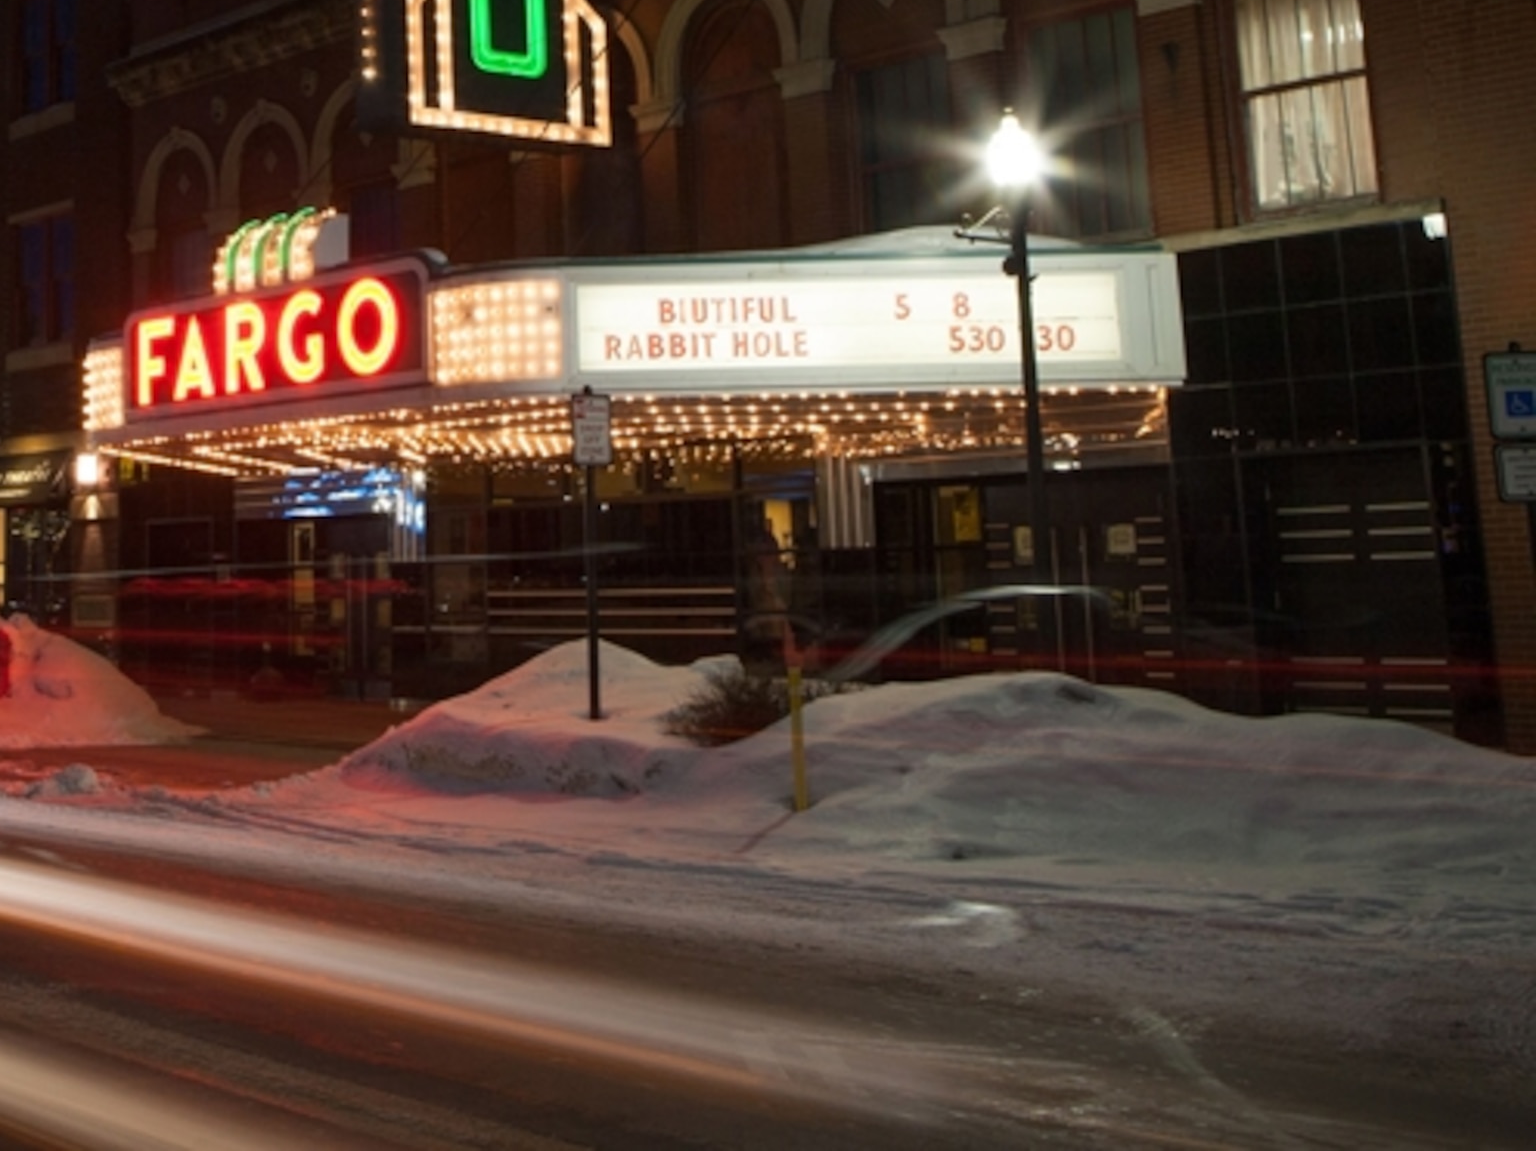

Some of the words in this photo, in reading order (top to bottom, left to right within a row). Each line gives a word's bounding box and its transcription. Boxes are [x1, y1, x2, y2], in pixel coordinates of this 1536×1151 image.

[658, 296, 797, 324] BIUTIFUL
[894, 293, 911, 320] 5
[952, 292, 971, 318] 8
[138, 277, 398, 406] FARGO
[605, 333, 716, 361] RABBIT
[732, 330, 809, 358] HOLE
[949, 325, 1005, 352] 530
